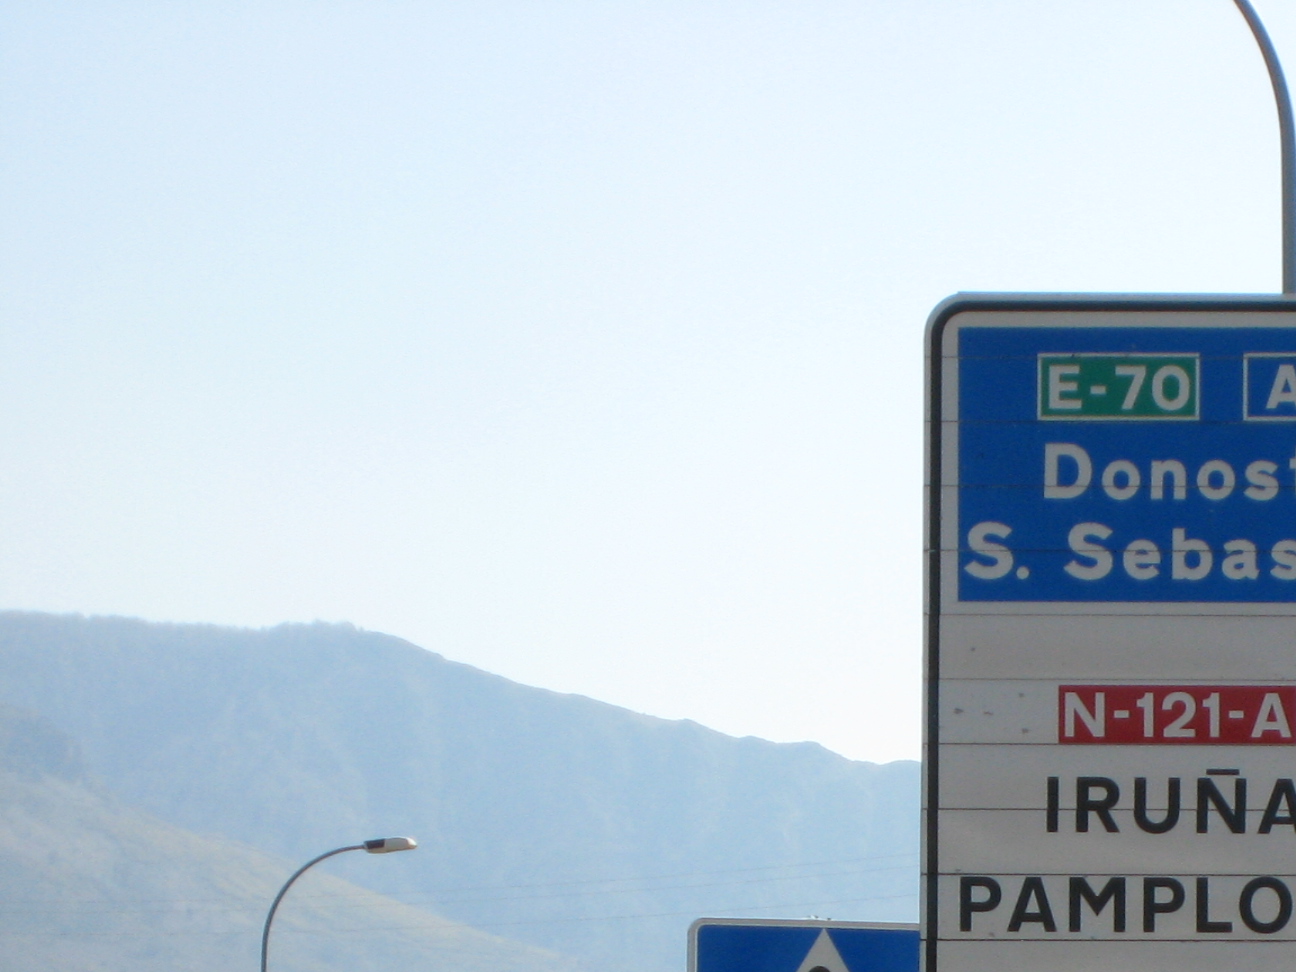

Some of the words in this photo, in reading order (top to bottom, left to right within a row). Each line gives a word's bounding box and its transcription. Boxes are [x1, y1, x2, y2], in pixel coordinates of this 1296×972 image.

[1047, 363, 1191, 411] E-70
[963, 521, 1030, 580] S.
[1063, 691, 1293, 739] N-121-A
